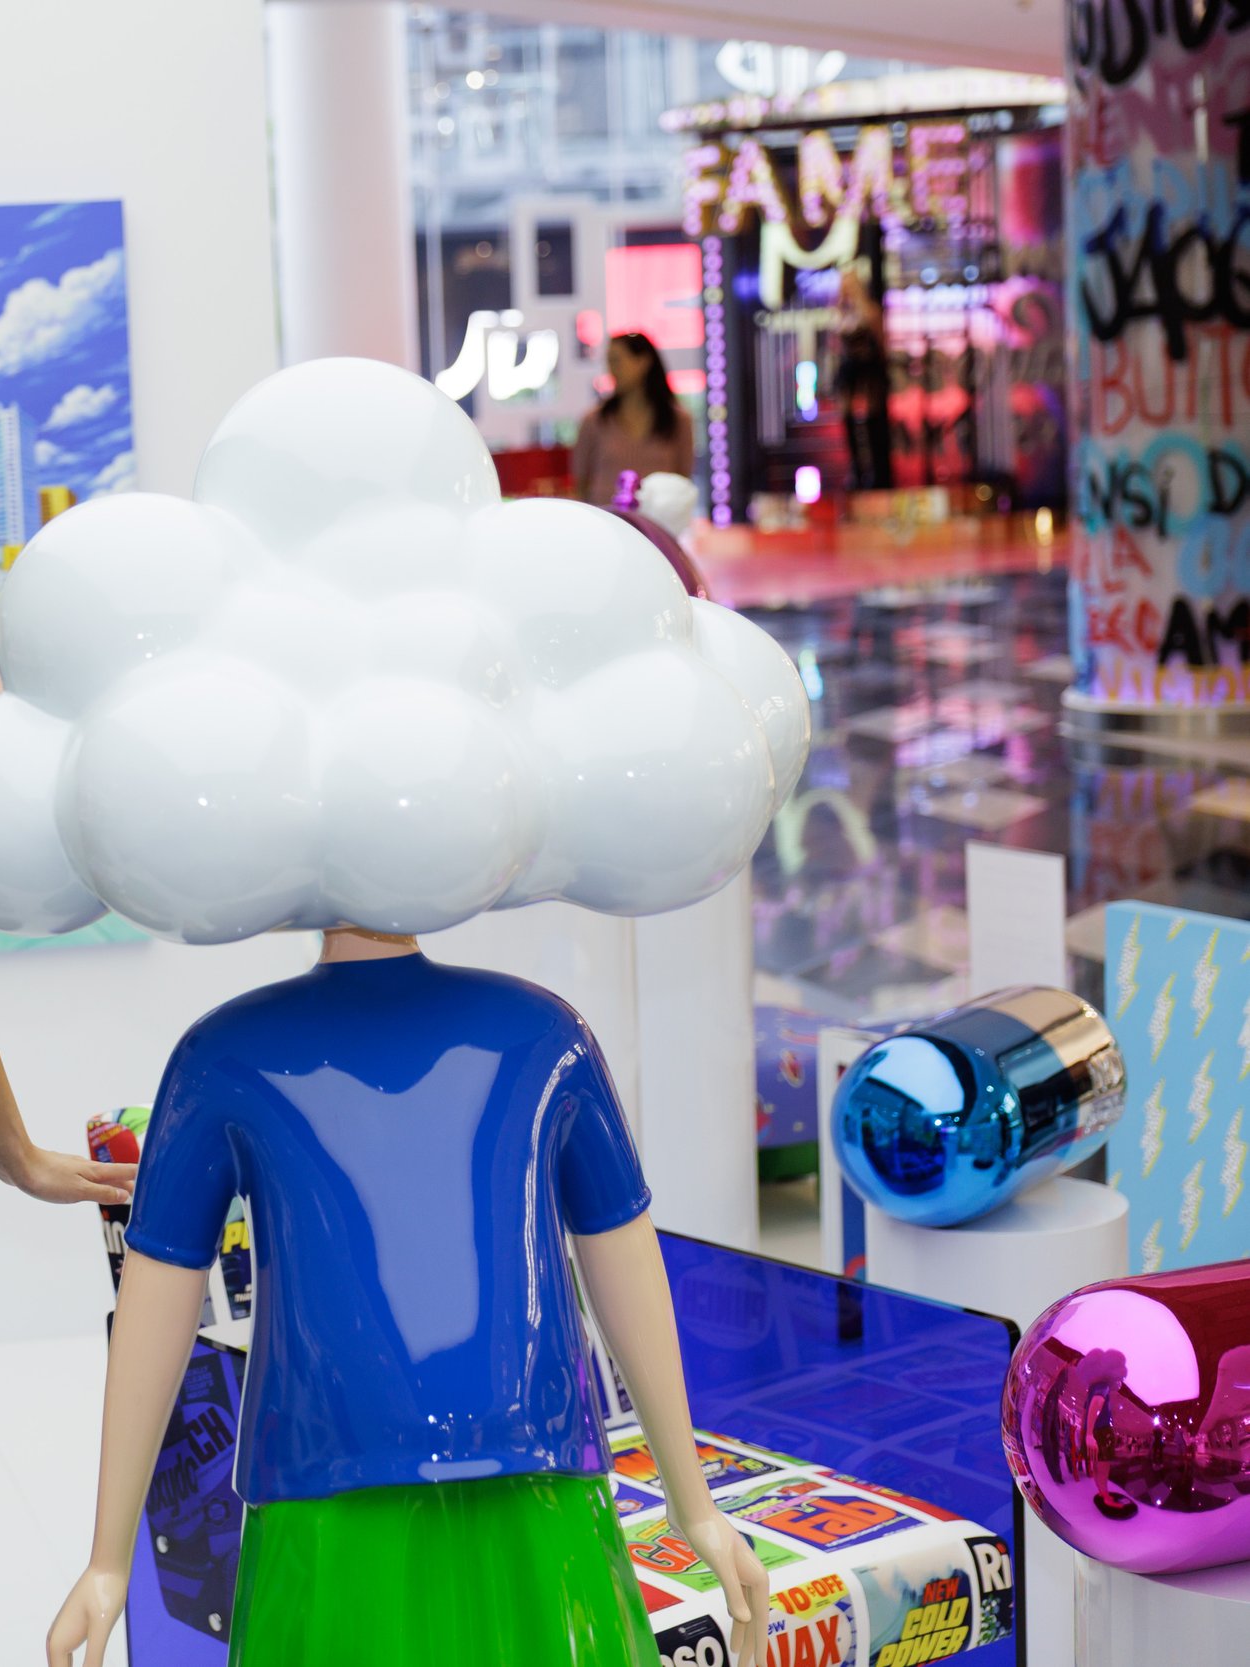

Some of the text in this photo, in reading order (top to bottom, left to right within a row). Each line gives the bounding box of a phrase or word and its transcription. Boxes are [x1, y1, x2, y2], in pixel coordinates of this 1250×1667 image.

[683, 122, 968, 237] FAME
[761, 1498, 898, 1544] Fab
[922, 1577, 960, 1605] NEW
[901, 1597, 969, 1641] COLD
[875, 1625, 969, 1667] POWER
